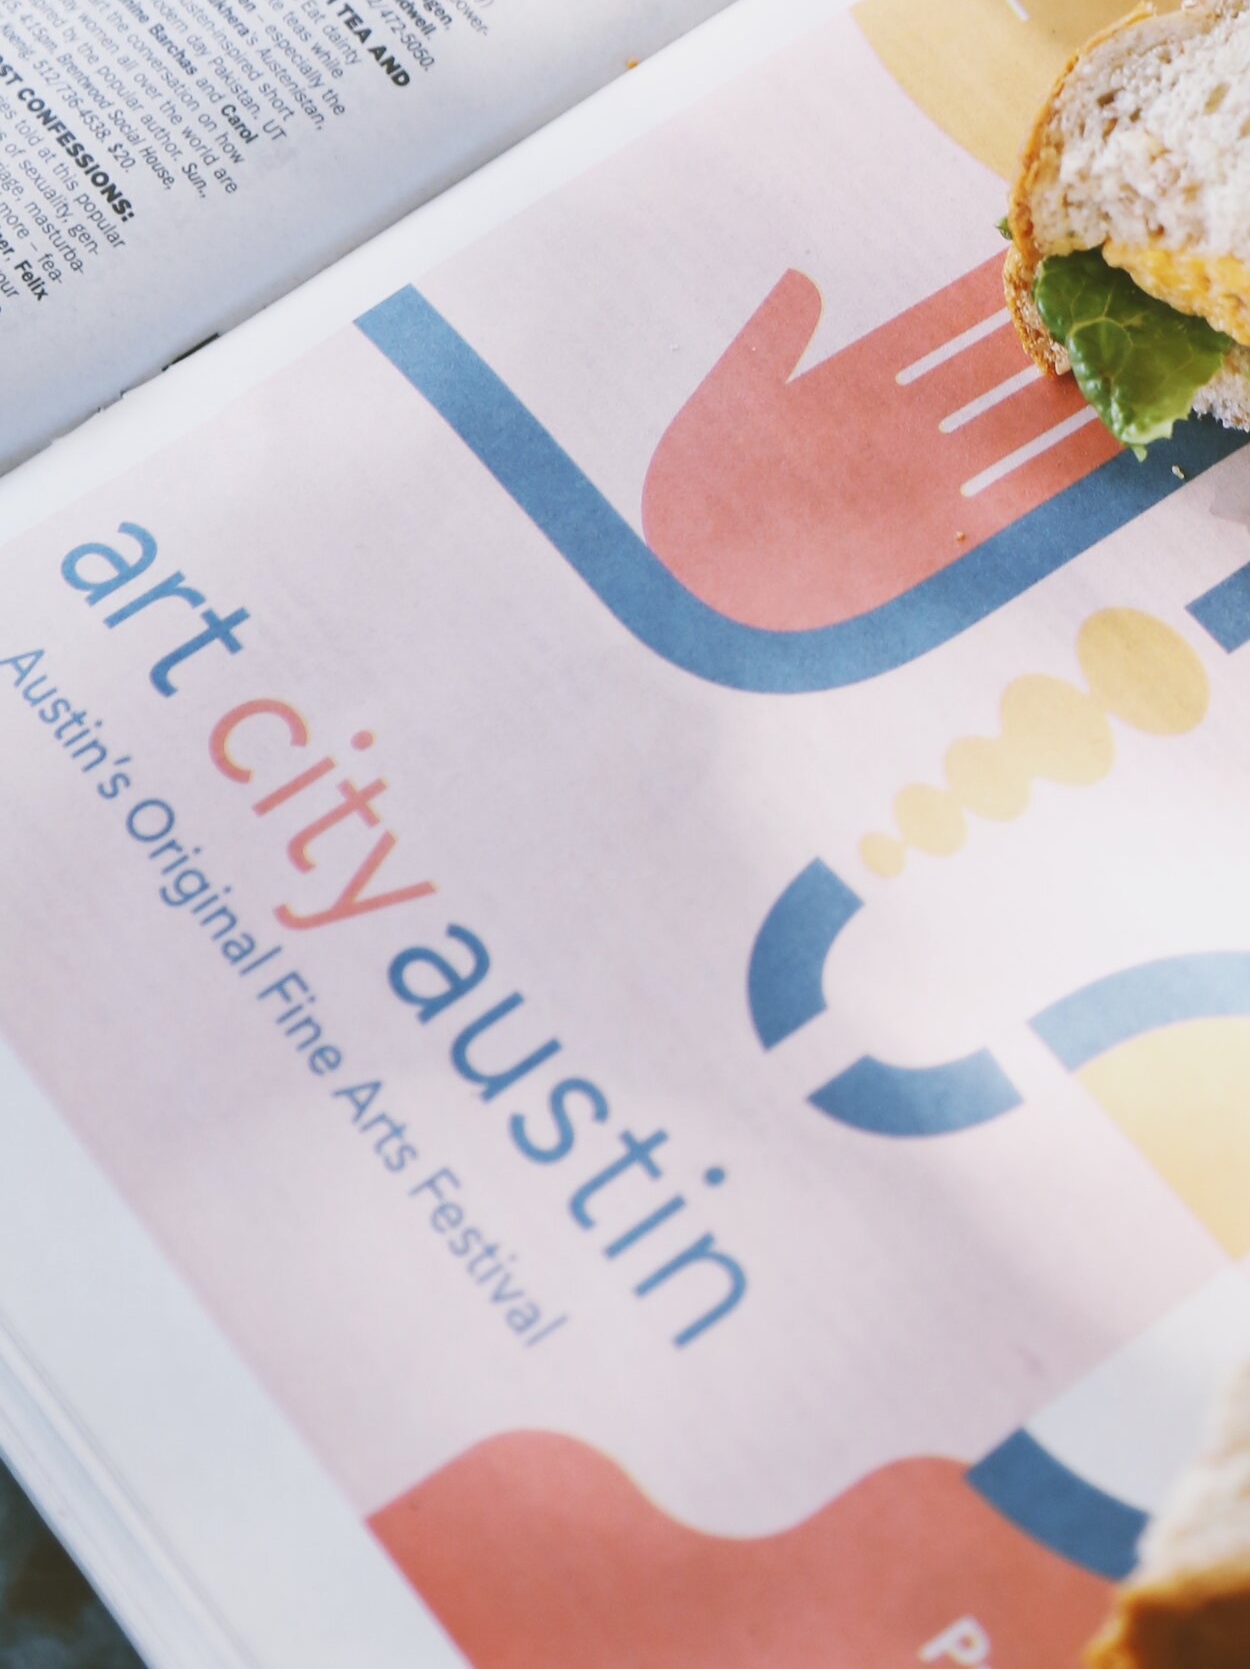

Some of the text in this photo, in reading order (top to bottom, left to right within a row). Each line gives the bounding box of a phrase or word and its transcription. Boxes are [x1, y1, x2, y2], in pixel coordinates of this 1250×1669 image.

[105, 9, 130, 34] the
[125, 32, 201, 113] conversation
[196, 111, 219, 134] on
[213, 129, 246, 165] how
[146, 21, 199, 77] Barchas
[193, 75, 226, 105] and
[218, 102, 260, 145] Carol
[184, 32, 210, 59] day
[206, 54, 262, 121] Pakistan.
[260, 117, 288, 142] UT
[255, 46, 326, 132] Austenistan,
[263, 23, 326, 90] especially
[319, 86, 347, 117] the
[280, 8, 313, 44] teas
[308, 40, 345, 80] while
[320, 22, 363, 66] dainty
[335, 2, 373, 44] TEA
[366, 43, 411, 88] AND
[54, 51, 176, 191] Brentwood Social House,
[75, 40, 101, 66] the
[93, 63, 146, 113] popular
[138, 112, 184, 162] author.
[179, 160, 208, 200] Sun.,
[76, 10, 239, 195] women all over the world are
[256, 81, 296, 123] short
[2, 141, 100, 256] of sexuality, gen-
[13, 117, 127, 249] told at this popular
[16, 86, 135, 223] CONFESSIONS:
[105, 140, 137, 174] $20.
[0, 200, 63, 285] more fea-
[12, 257, 49, 302] Felix
[23, 199, 85, 275] masturba-
[60, 520, 749, 1350] art city austin
[0, 647, 570, 1347] Austin's Original Fine Arts Festival
[917, 1614, 993, 1669] P
